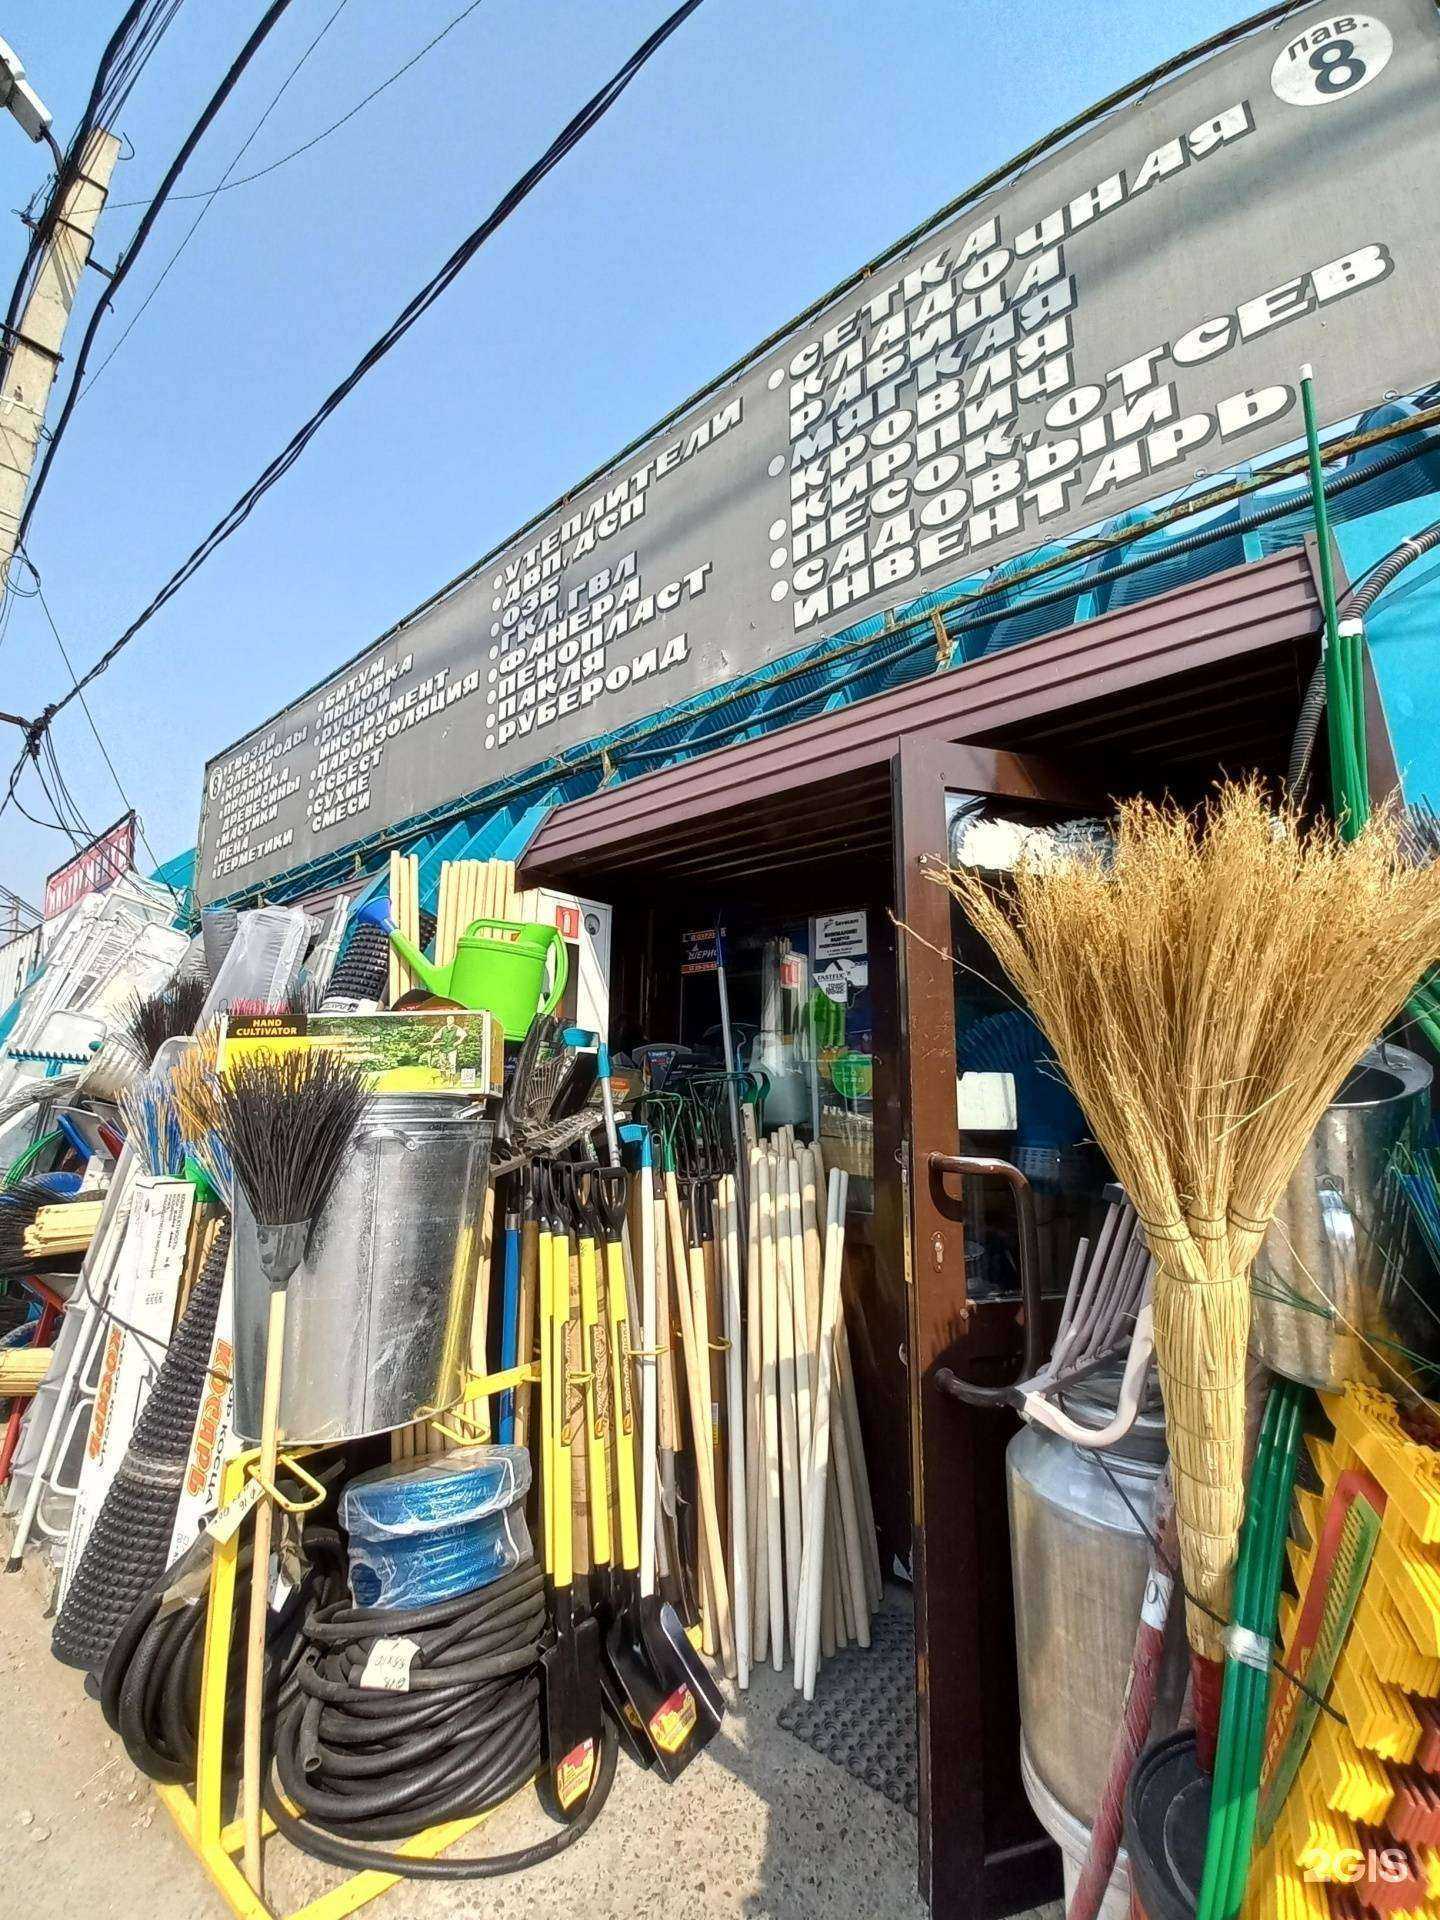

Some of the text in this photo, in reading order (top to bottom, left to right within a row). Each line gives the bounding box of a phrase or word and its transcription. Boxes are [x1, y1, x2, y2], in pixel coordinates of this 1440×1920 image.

[1309, 40, 1366, 94] 8
[789, 216, 1001, 379] СЕТКА
[790, 100, 1256, 405] КЛАДОЧНАЯ
[790, 244, 1066, 444] РАБИЦА
[791, 275, 1077, 471] МЯГКАЯ
[791, 314, 1074, 503] КРОВЛЯ
[791, 351, 1074, 536] КИРПИЧ
[792, 242, 1395, 568] ПЕСОК, ОТСЕВ
[504, 397, 743, 586] УТЕПЛИТЕЛИ
[792, 381, 1179, 594] САДОВЫЙ
[793, 384, 1297, 634] ИНВЕНТАРЬ
[504, 492, 647, 609] ДВП, ДСП
[499, 576, 641, 674] ФАНЕРА
[499, 561, 713, 699] ПЕНОПЛАСТ
[500, 551, 637, 654] ГКЛ, ГВЛ
[316, 669, 480, 779] ПАРОИЗОЛЯЦИЯ
[320, 668, 450, 761] ИНСТРУМЕНТ
[323, 653, 413, 727] ПЫЛОВКА
[325, 656, 385, 711] БИТУМ
[498, 633, 692, 748] РУБЕРОИД
[499, 646, 606, 721] ПАКЛЯ
[223, 767, 290, 817] ПРОПИТКА
[225, 762, 273, 803] КРАСКИ
[226, 725, 308, 788] ЭЛЕКТРОДЫ
[228, 732, 276, 774] ГВОЗДИ
[313, 773, 370, 815] СУХИЕ
[315, 747, 383, 797] АСБЕСТ
[218, 836, 250, 862] ПЕНА
[220, 804, 278, 847] МАСТИКИ
[222, 776, 301, 832] ДРЕВЕСИНЫ
[312, 790, 371, 834] СМЕСИ
[216, 828, 294, 879] ГЕРМЕТИКИ
[236, 1027, 298, 1036] CULTIVATOR
[252, 1018, 282, 1027] HAND
[88, 1323, 121, 1460] КОСАРЬ
[187, 1339, 233, 1497] КОСАРЬ
[205, 1424, 228, 1505] КОСЦА
